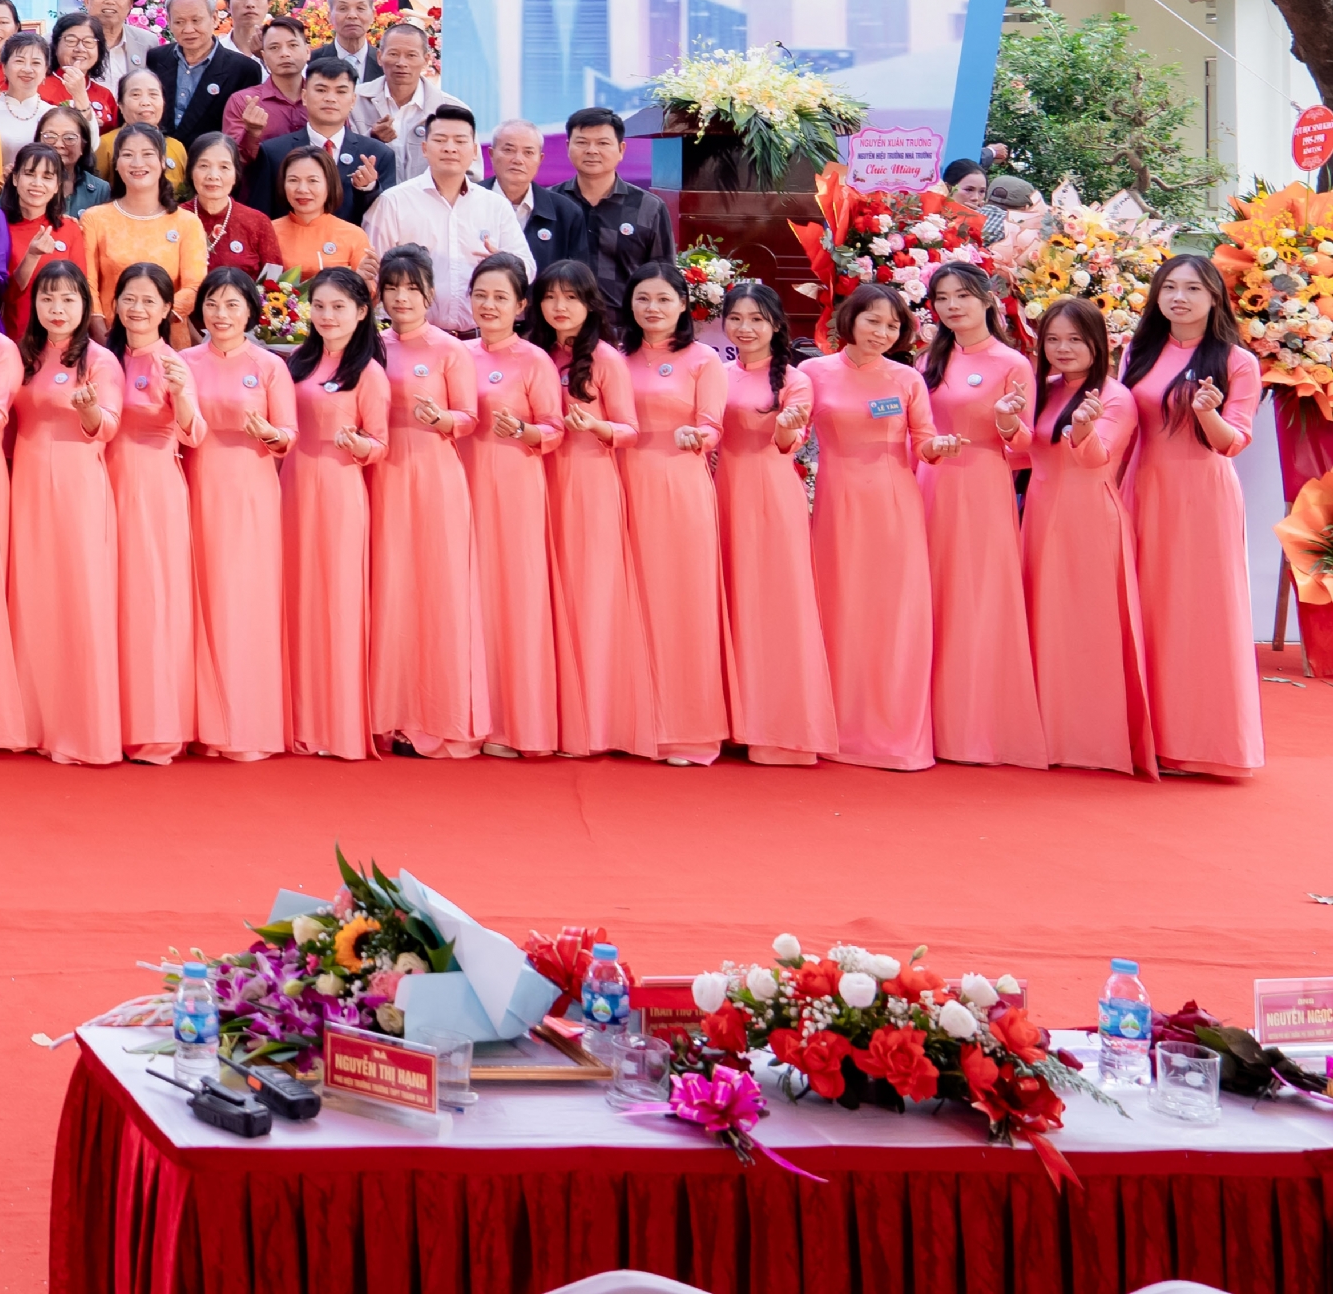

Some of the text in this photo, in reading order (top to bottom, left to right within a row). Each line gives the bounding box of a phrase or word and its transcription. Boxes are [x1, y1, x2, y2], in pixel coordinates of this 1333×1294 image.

[860, 136, 931, 147] NGUYỄN XUÂN TRƯỜNG
[866, 164, 921, 178] Chúc Mừng
[1267, 1006, 1304, 1027] NGUYỄN
[335, 1054, 428, 1090] NGUYỄN THỊ HẠNH
